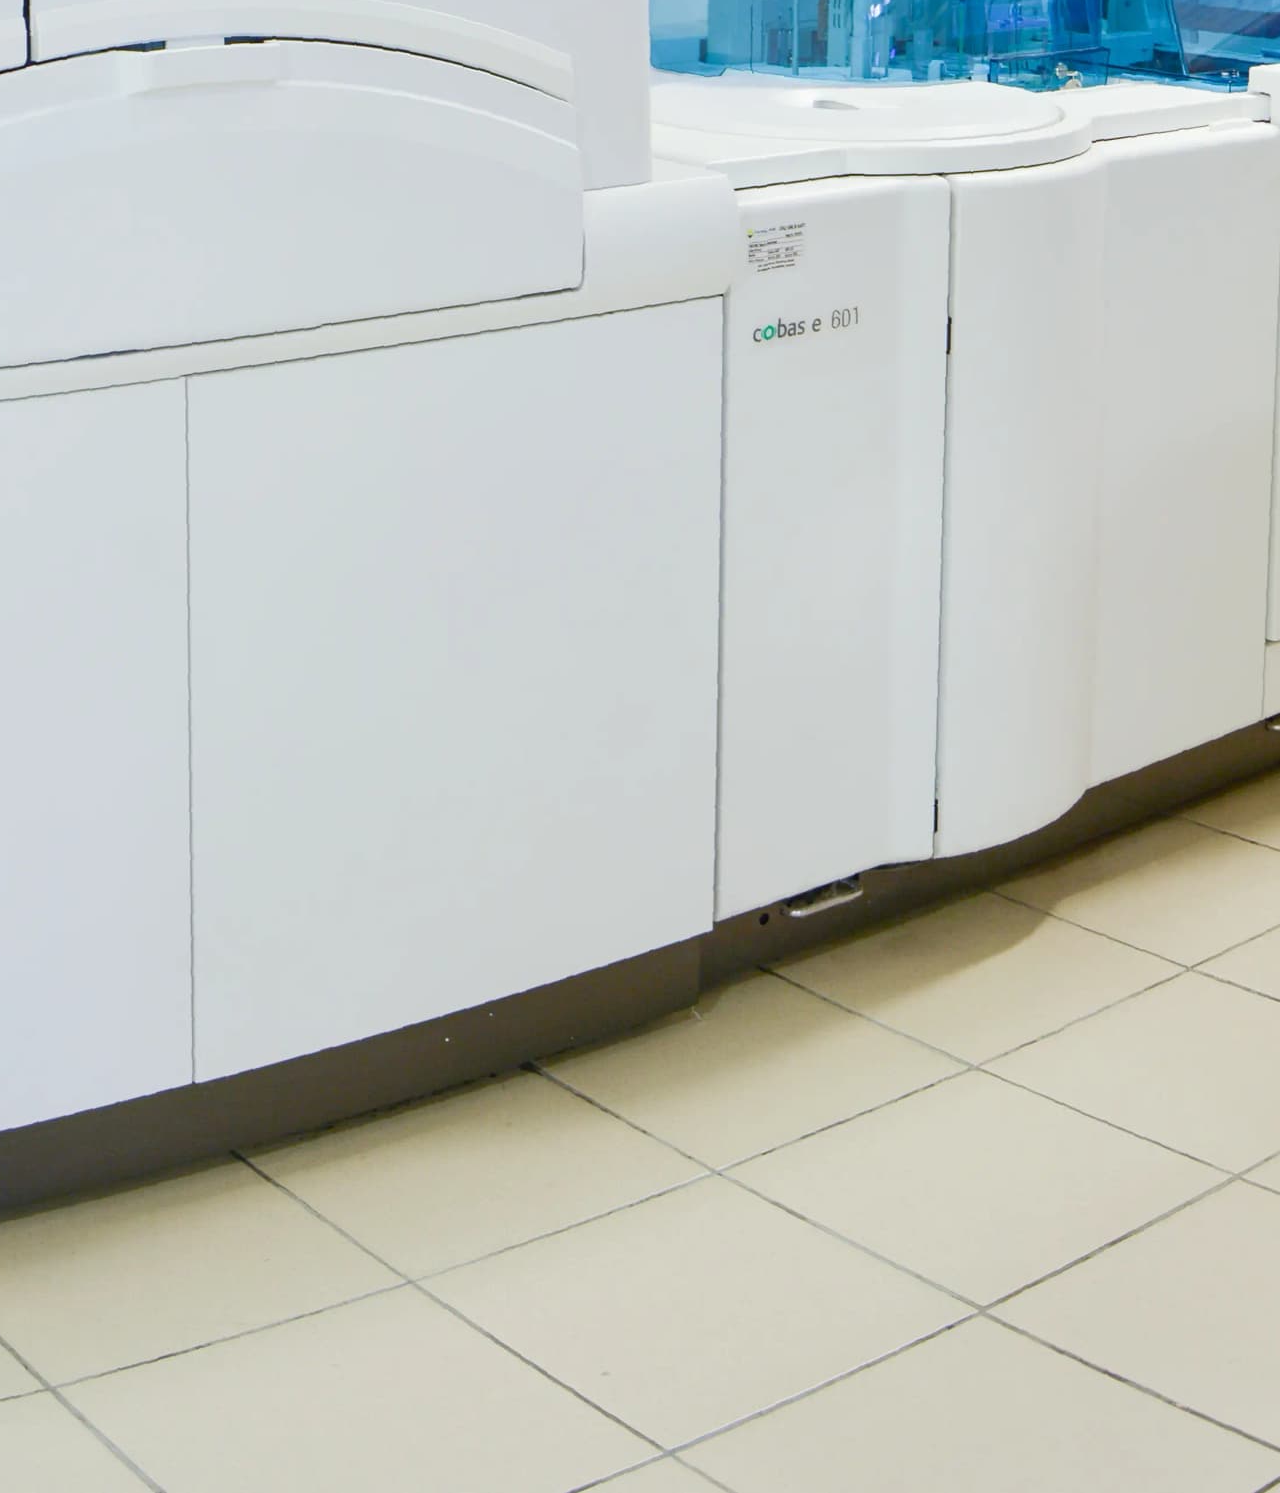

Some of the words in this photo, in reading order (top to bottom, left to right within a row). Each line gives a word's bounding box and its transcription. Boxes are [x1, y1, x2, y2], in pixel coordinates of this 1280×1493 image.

[752, 316, 806, 343] cobas
[811, 317, 822, 333] e
[831, 306, 859, 329] 601
